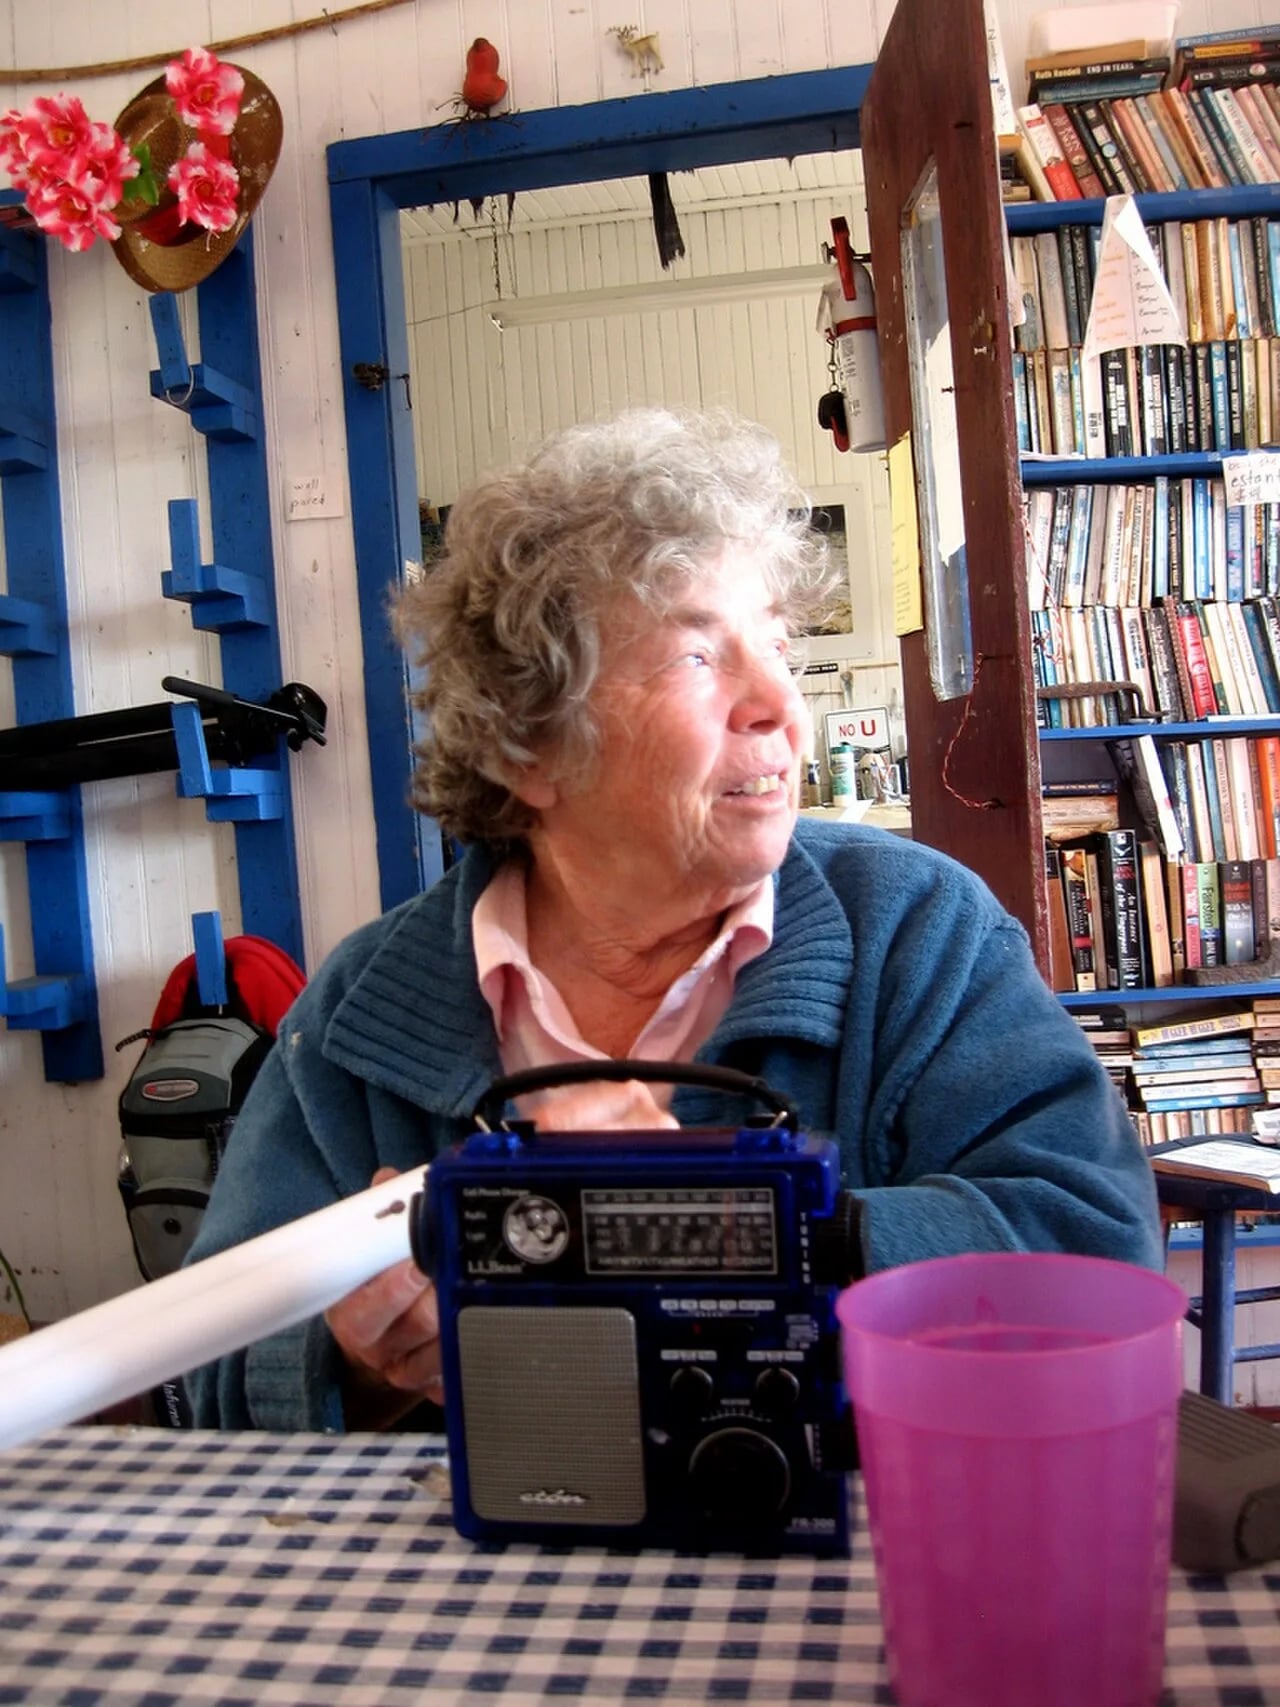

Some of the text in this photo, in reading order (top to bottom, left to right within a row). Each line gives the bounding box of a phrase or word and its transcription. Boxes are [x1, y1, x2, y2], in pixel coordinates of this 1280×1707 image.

[1035, 62, 1134, 80] Ruth Rendell END IN TEARS
[293, 478, 320, 490] wall
[838, 719, 876, 737] NO U
[1114, 883, 1126, 893] of
[1118, 894, 1127, 908] the
